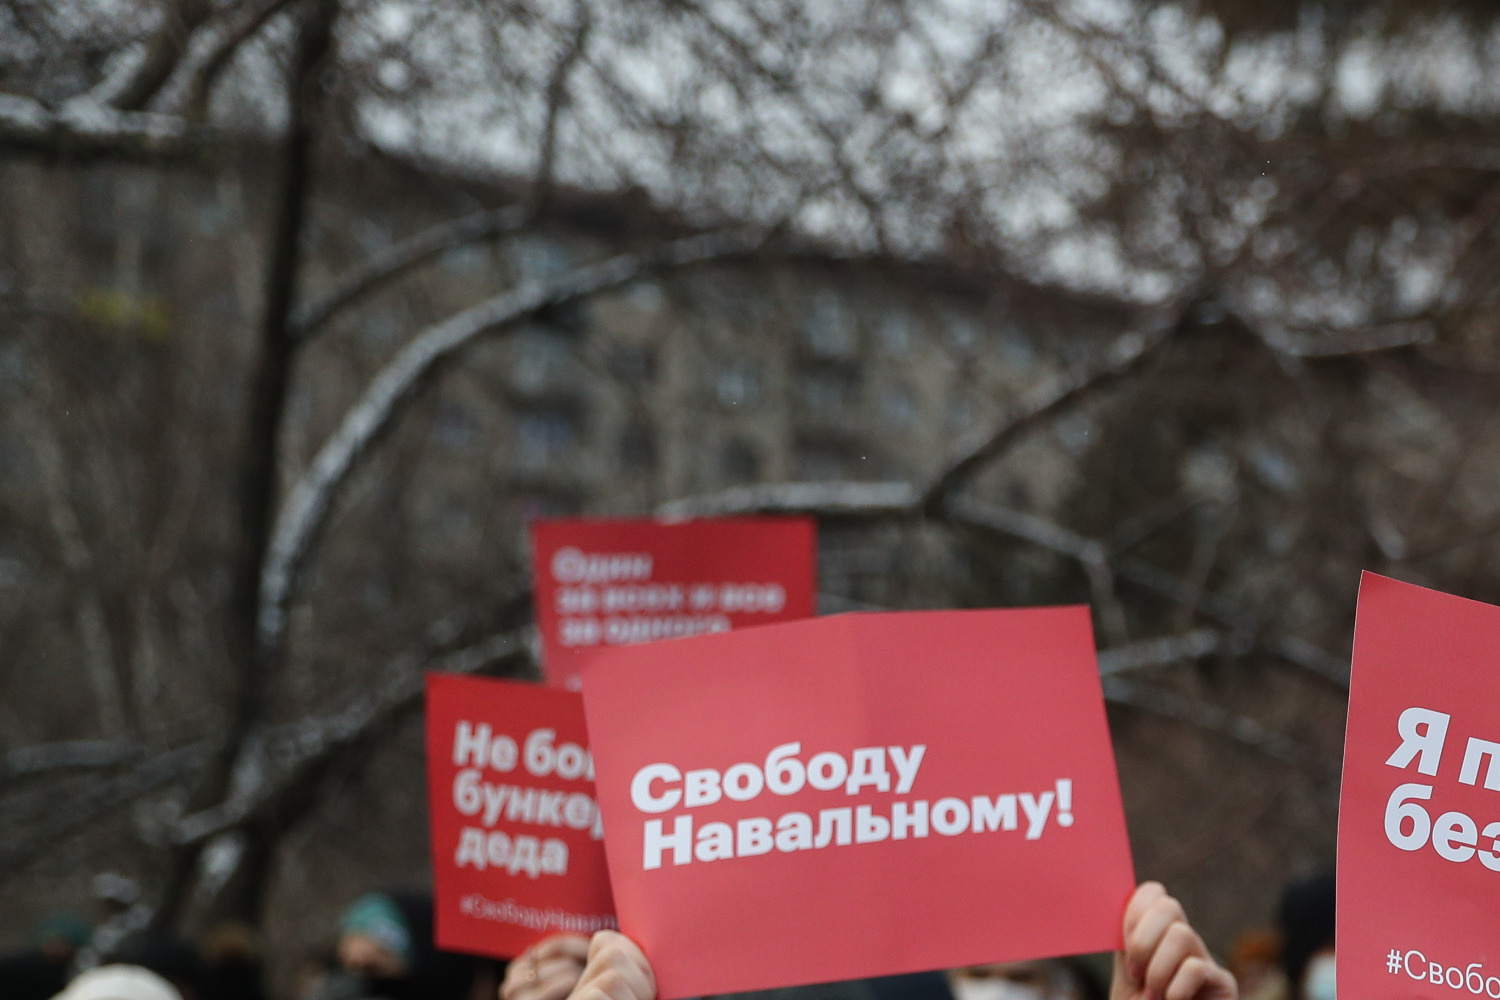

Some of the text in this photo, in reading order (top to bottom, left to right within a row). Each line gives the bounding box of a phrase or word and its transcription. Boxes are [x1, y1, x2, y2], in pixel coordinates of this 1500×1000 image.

[454, 719, 519, 773] Не
[1385, 707, 1451, 777] Я
[629, 741, 927, 814] Свободу
[455, 826, 570, 879] деда
[642, 778, 1076, 871] Навальному!
